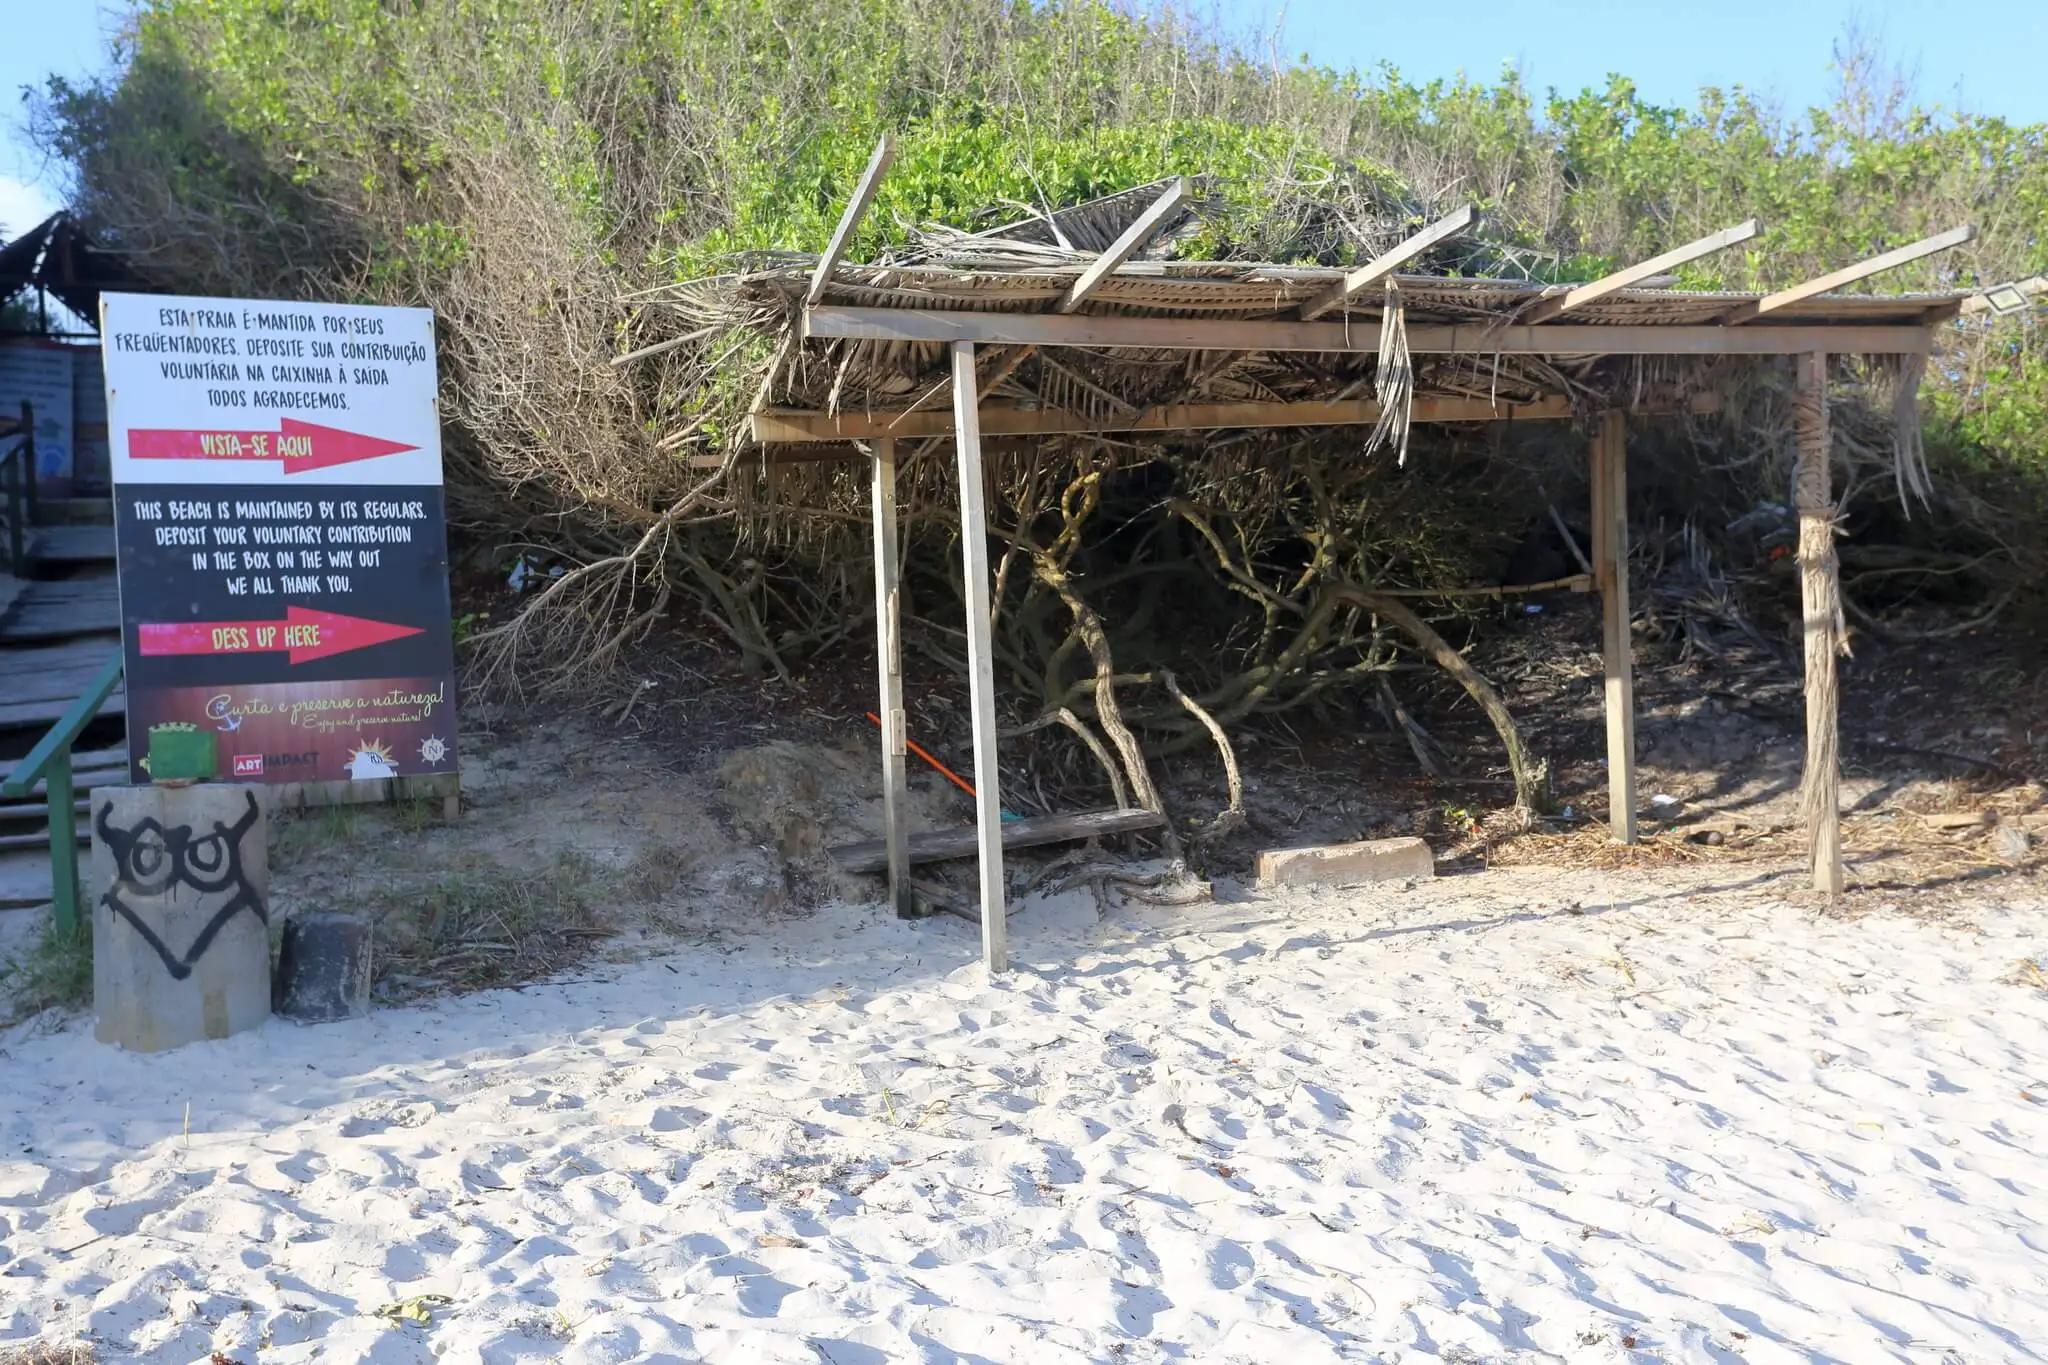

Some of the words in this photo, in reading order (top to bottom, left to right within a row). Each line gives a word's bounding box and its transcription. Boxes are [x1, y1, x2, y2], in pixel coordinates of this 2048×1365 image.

[160, 309, 190, 327] ESTA
[198, 310, 236, 329] PRAIA
[243, 308, 251, 329] É
[258, 312, 316, 332] MANTIDA
[324, 315, 348, 335] POR
[353, 317, 384, 335] SEUS
[115, 333, 241, 356] FREQÜENTADORES.
[246, 338, 304, 358] DEPOSITE
[311, 341, 335, 359] SUA
[341, 341, 426, 365] CONTRIBUIÇÃO
[160, 360, 239, 381] VOLUNTÁRIA
[247, 365, 265, 382] NA
[272, 365, 333, 384] CAIXINHA
[339, 363, 348, 384] À
[355, 366, 389, 386] SAÍDA
[207, 389, 247, 408] TODOS
[254, 391, 350, 410] AGRADECEMOS.
[200, 434, 269, 456] VISTA-SE
[277, 436, 313, 457] AQUI
[134, 501, 162, 520] THIS
[169, 501, 212, 520] BEACH
[218, 501, 229, 520] IS
[236, 501, 312, 520] MAINTAINED
[319, 501, 335, 520] BY
[341, 501, 357, 519] ITS
[363, 501, 427, 520] REGULARS.
[155, 526, 206, 546] DEPOSIT
[213, 526, 247, 545] YOUR
[253, 525, 322, 544] VOLUNTARY
[328, 525, 411, 543] CONTRIBUTION
[192, 553, 207, 571] IN
[213, 552, 237, 570] THE
[244, 552, 270, 570] BOX
[277, 551, 294, 569] ON
[300, 550, 323, 569] THE
[329, 550, 353, 568] WAY
[359, 549, 380, 568] OUT
[227, 577, 247, 595] WE
[253, 576, 274, 595] ALL
[281, 575, 321, 594] THANK
[327, 575, 352, 593] YOU.
[212, 627, 248, 650] DESS
[256, 626, 277, 648] UP
[284, 625, 320, 647] HERE
[206, 694, 273, 719] Curta
[279, 703, 288, 712] e
[291, 698, 354, 725] preserve
[357, 698, 368, 708] a
[373, 681, 444, 717] natureza!
[237, 760, 261, 771] ART
[264, 752, 320, 767] IMPACT
